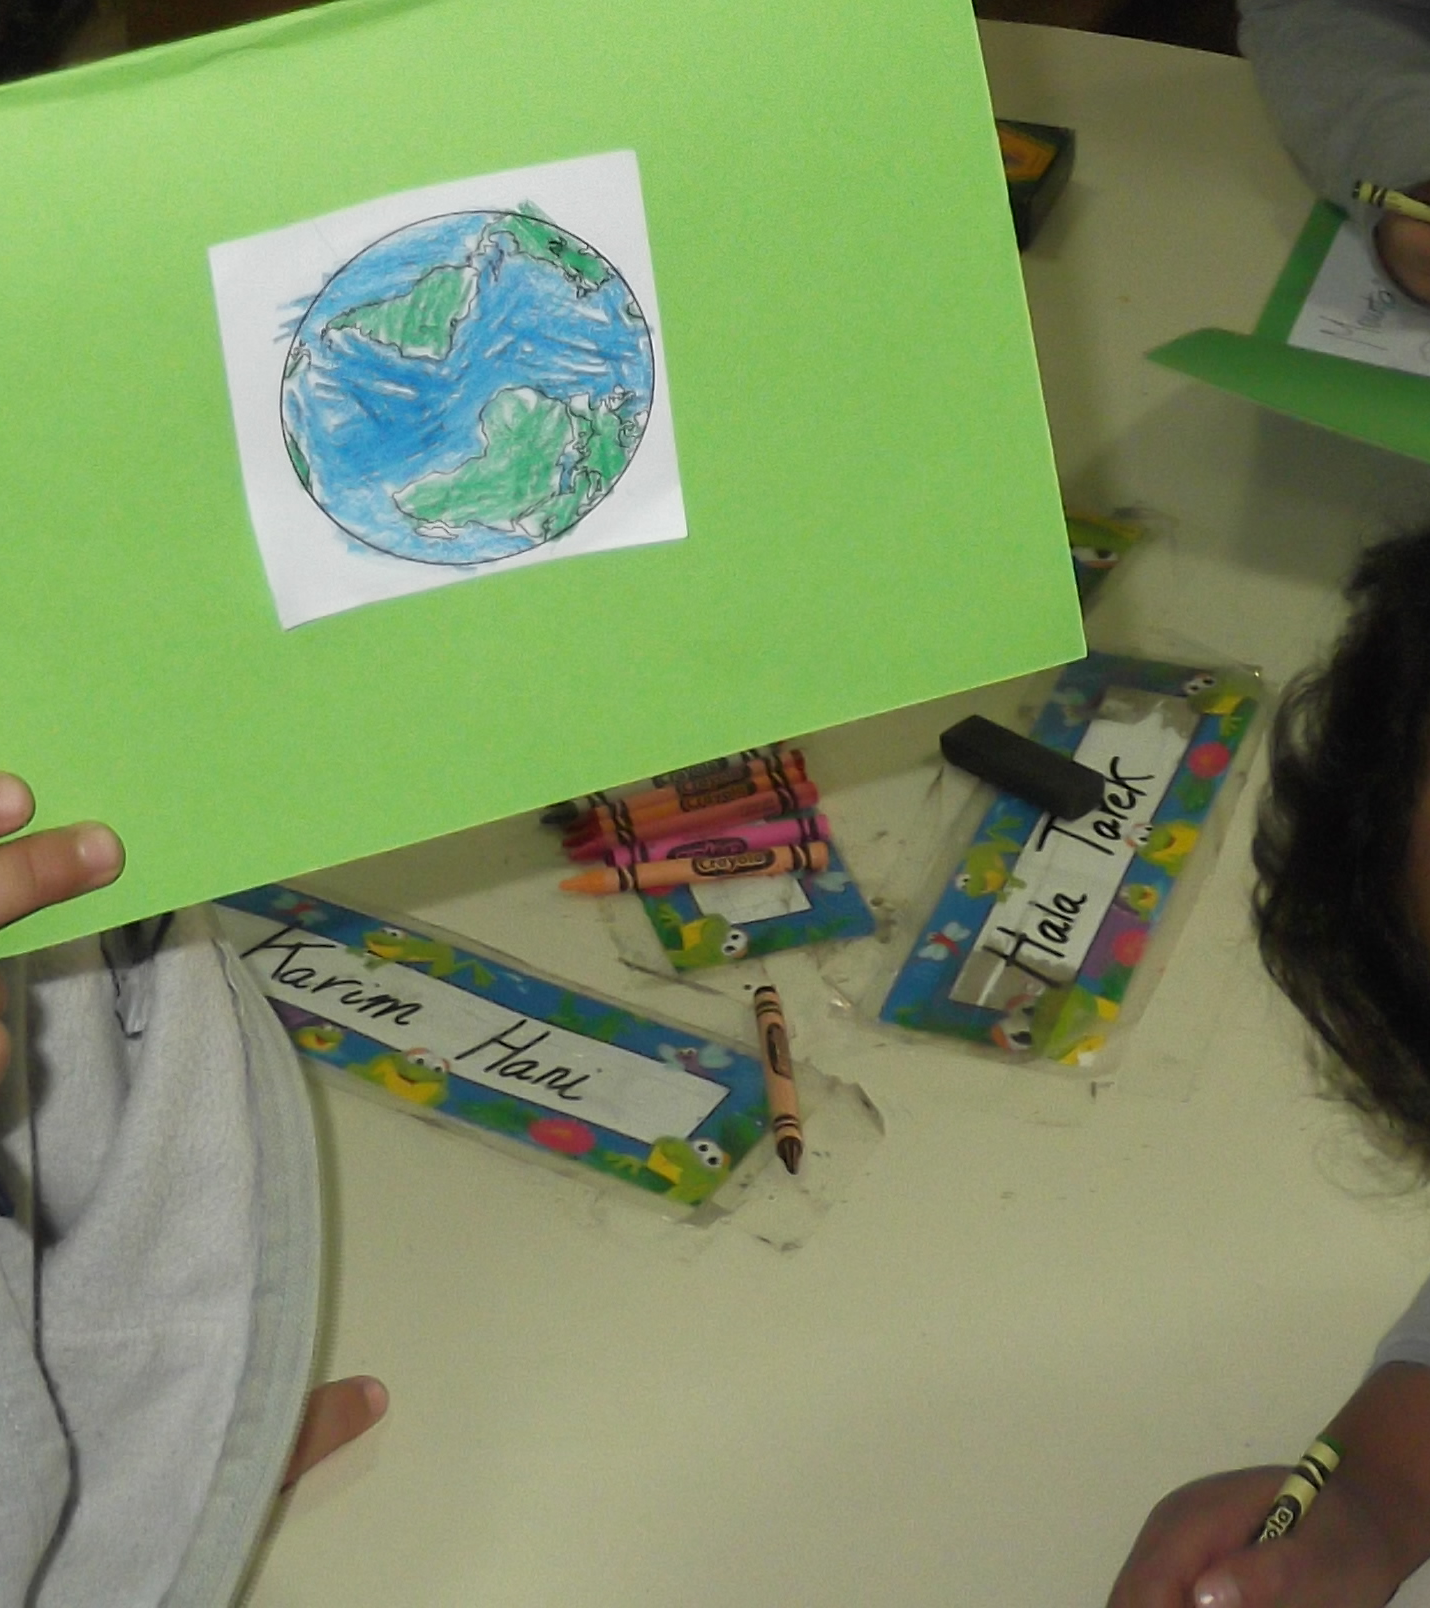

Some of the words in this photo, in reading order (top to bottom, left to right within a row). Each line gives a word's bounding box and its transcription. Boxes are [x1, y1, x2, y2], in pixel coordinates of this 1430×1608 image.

[695, 853, 767, 873] Crayola
[981, 892, 1089, 989] Hala
[239, 920, 424, 1026] Karim
[454, 1018, 603, 1101] Hani
